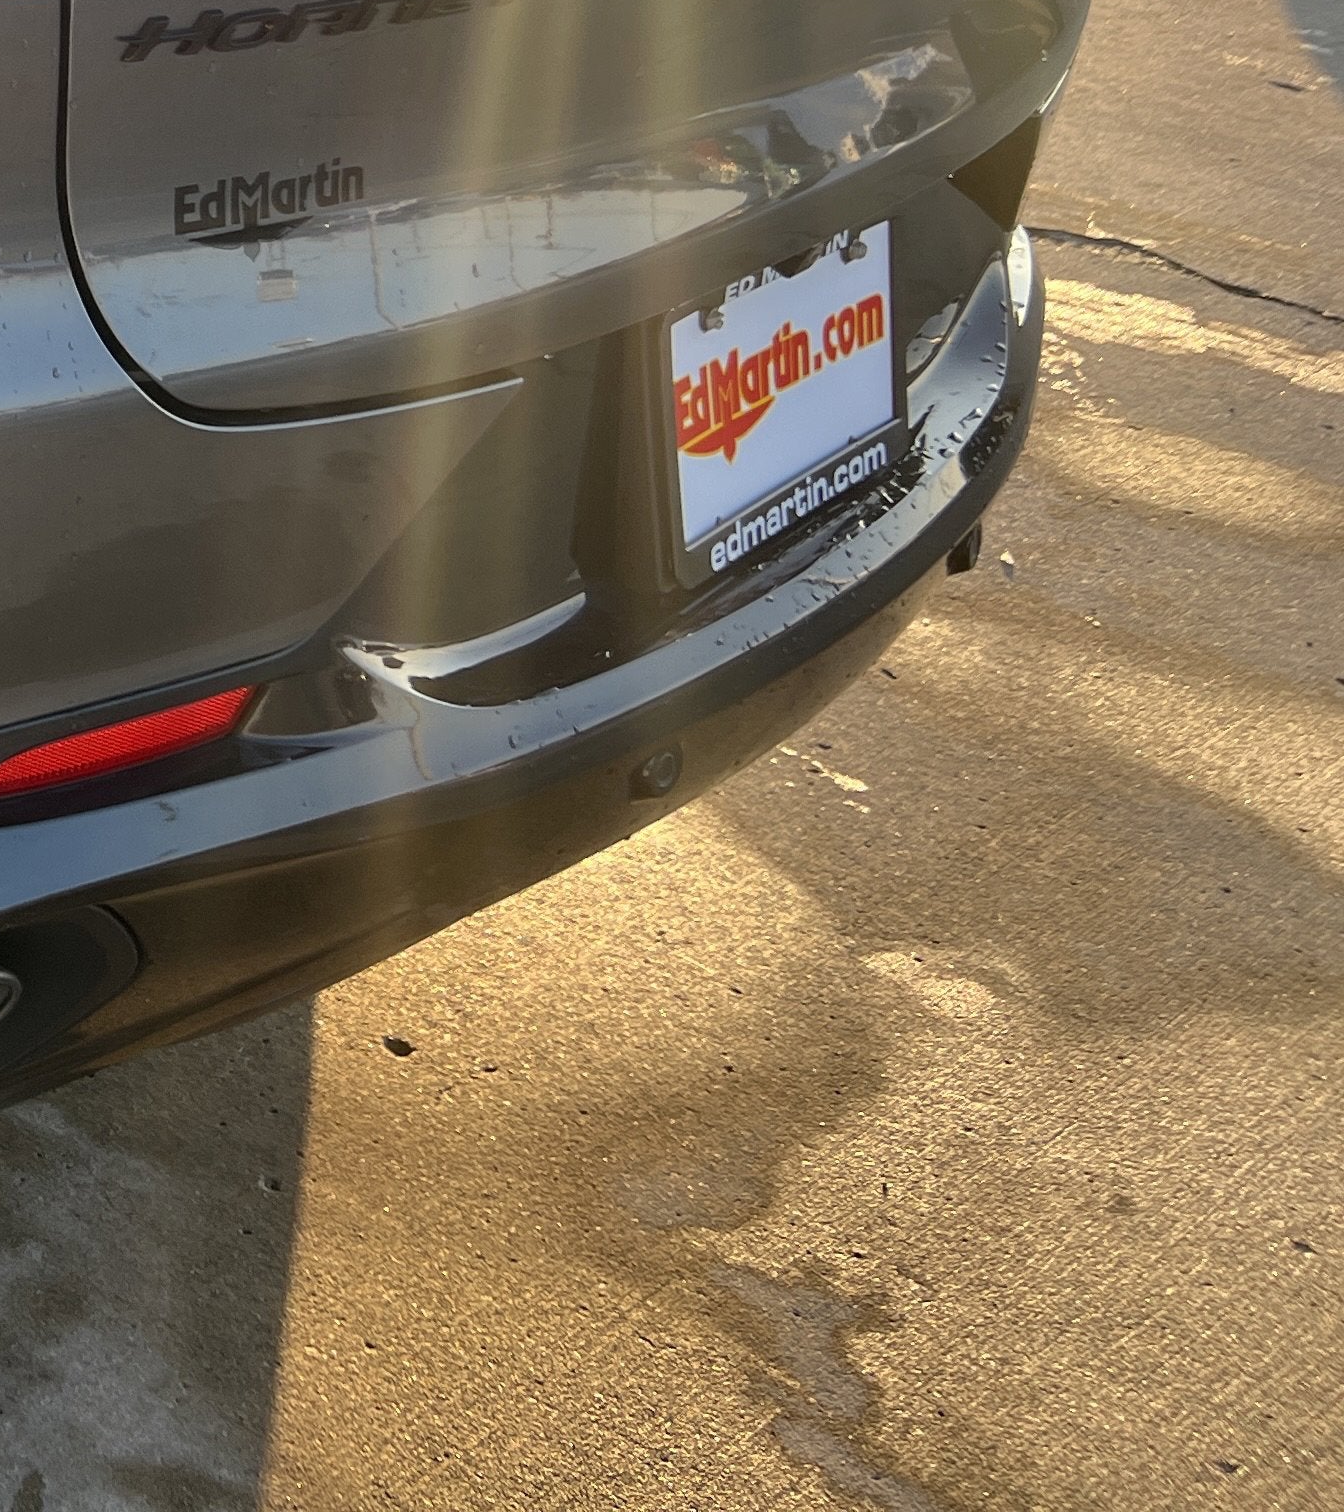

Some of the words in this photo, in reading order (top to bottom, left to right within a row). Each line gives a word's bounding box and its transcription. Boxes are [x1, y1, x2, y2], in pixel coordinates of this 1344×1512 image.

[174, 157, 363, 236] EdMartin
[673, 292, 885, 449] EdMartin.com
[710, 442, 888, 573] edmartin.com
